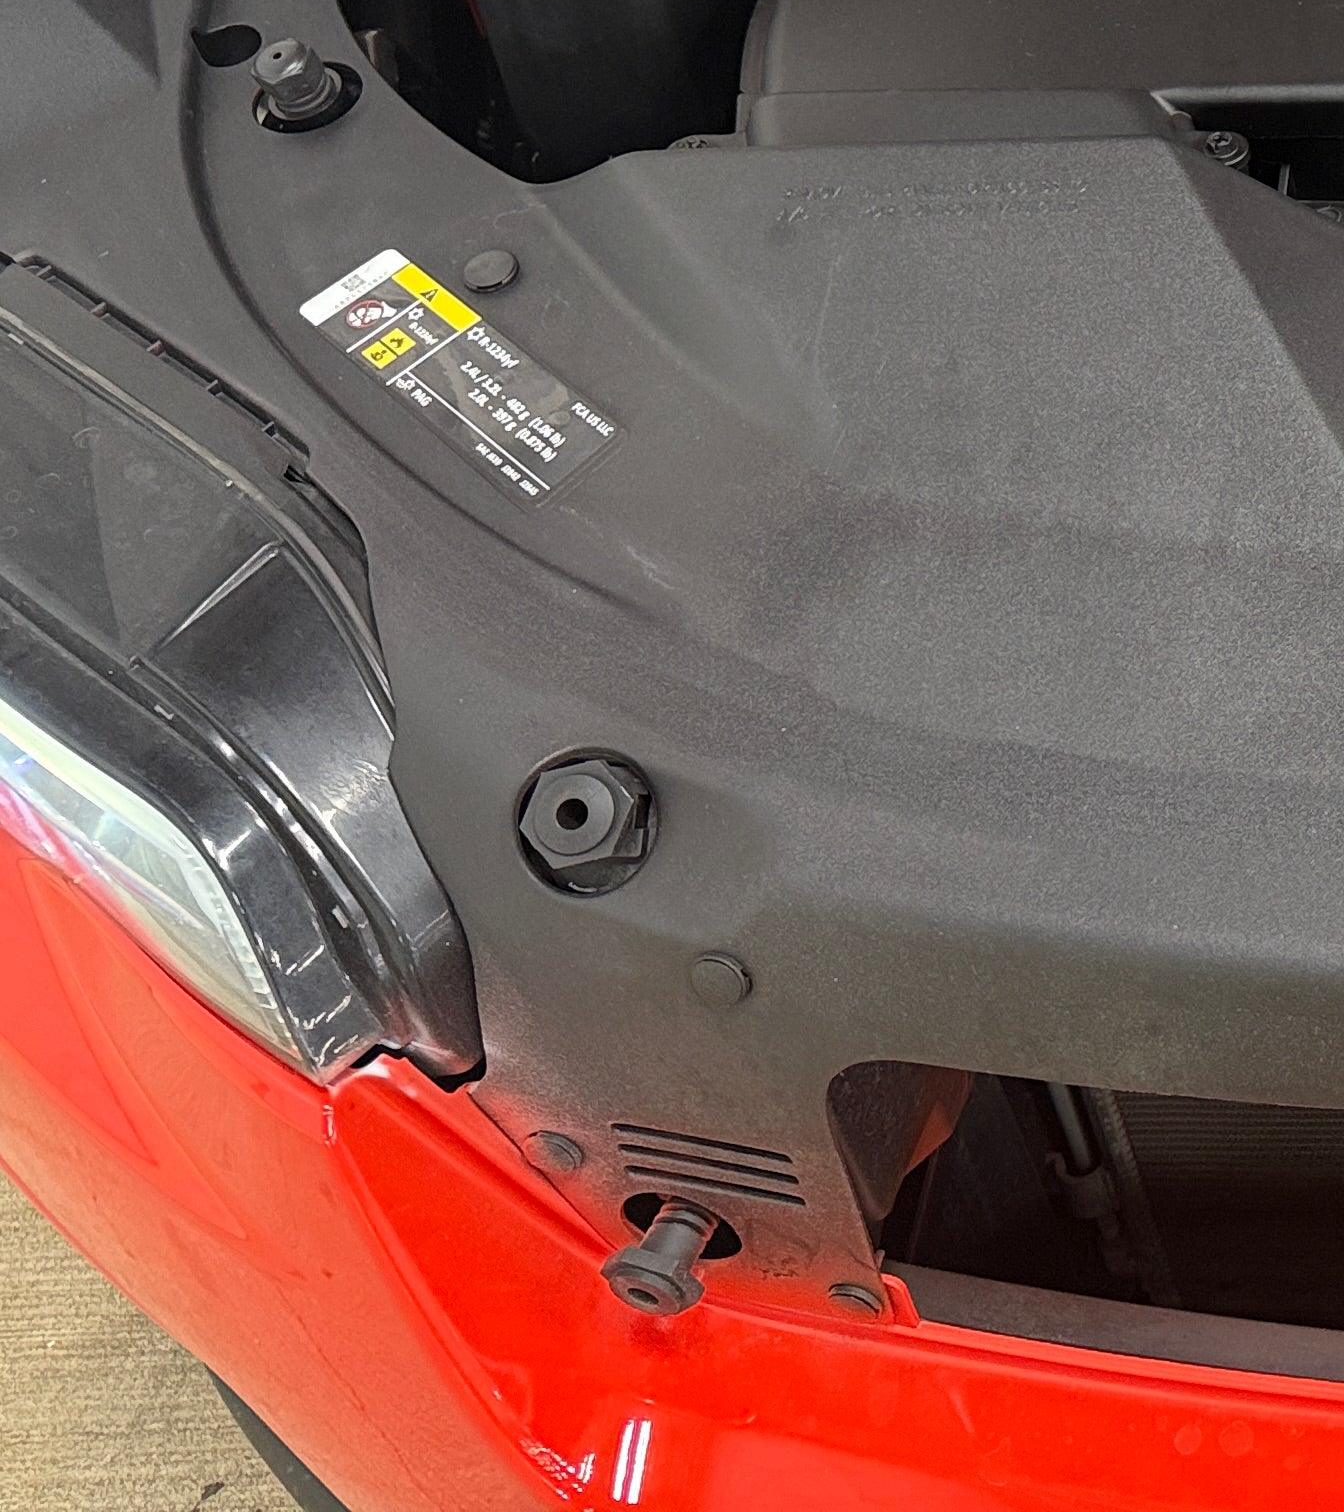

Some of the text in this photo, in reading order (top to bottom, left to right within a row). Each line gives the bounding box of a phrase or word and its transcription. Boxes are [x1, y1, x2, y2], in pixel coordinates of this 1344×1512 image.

[478, 336, 520, 368] R-1234yf
[410, 389, 432, 407] PAG
[492, 407, 514, 424] 397
[571, 402, 614, 436] FCA US LLC
